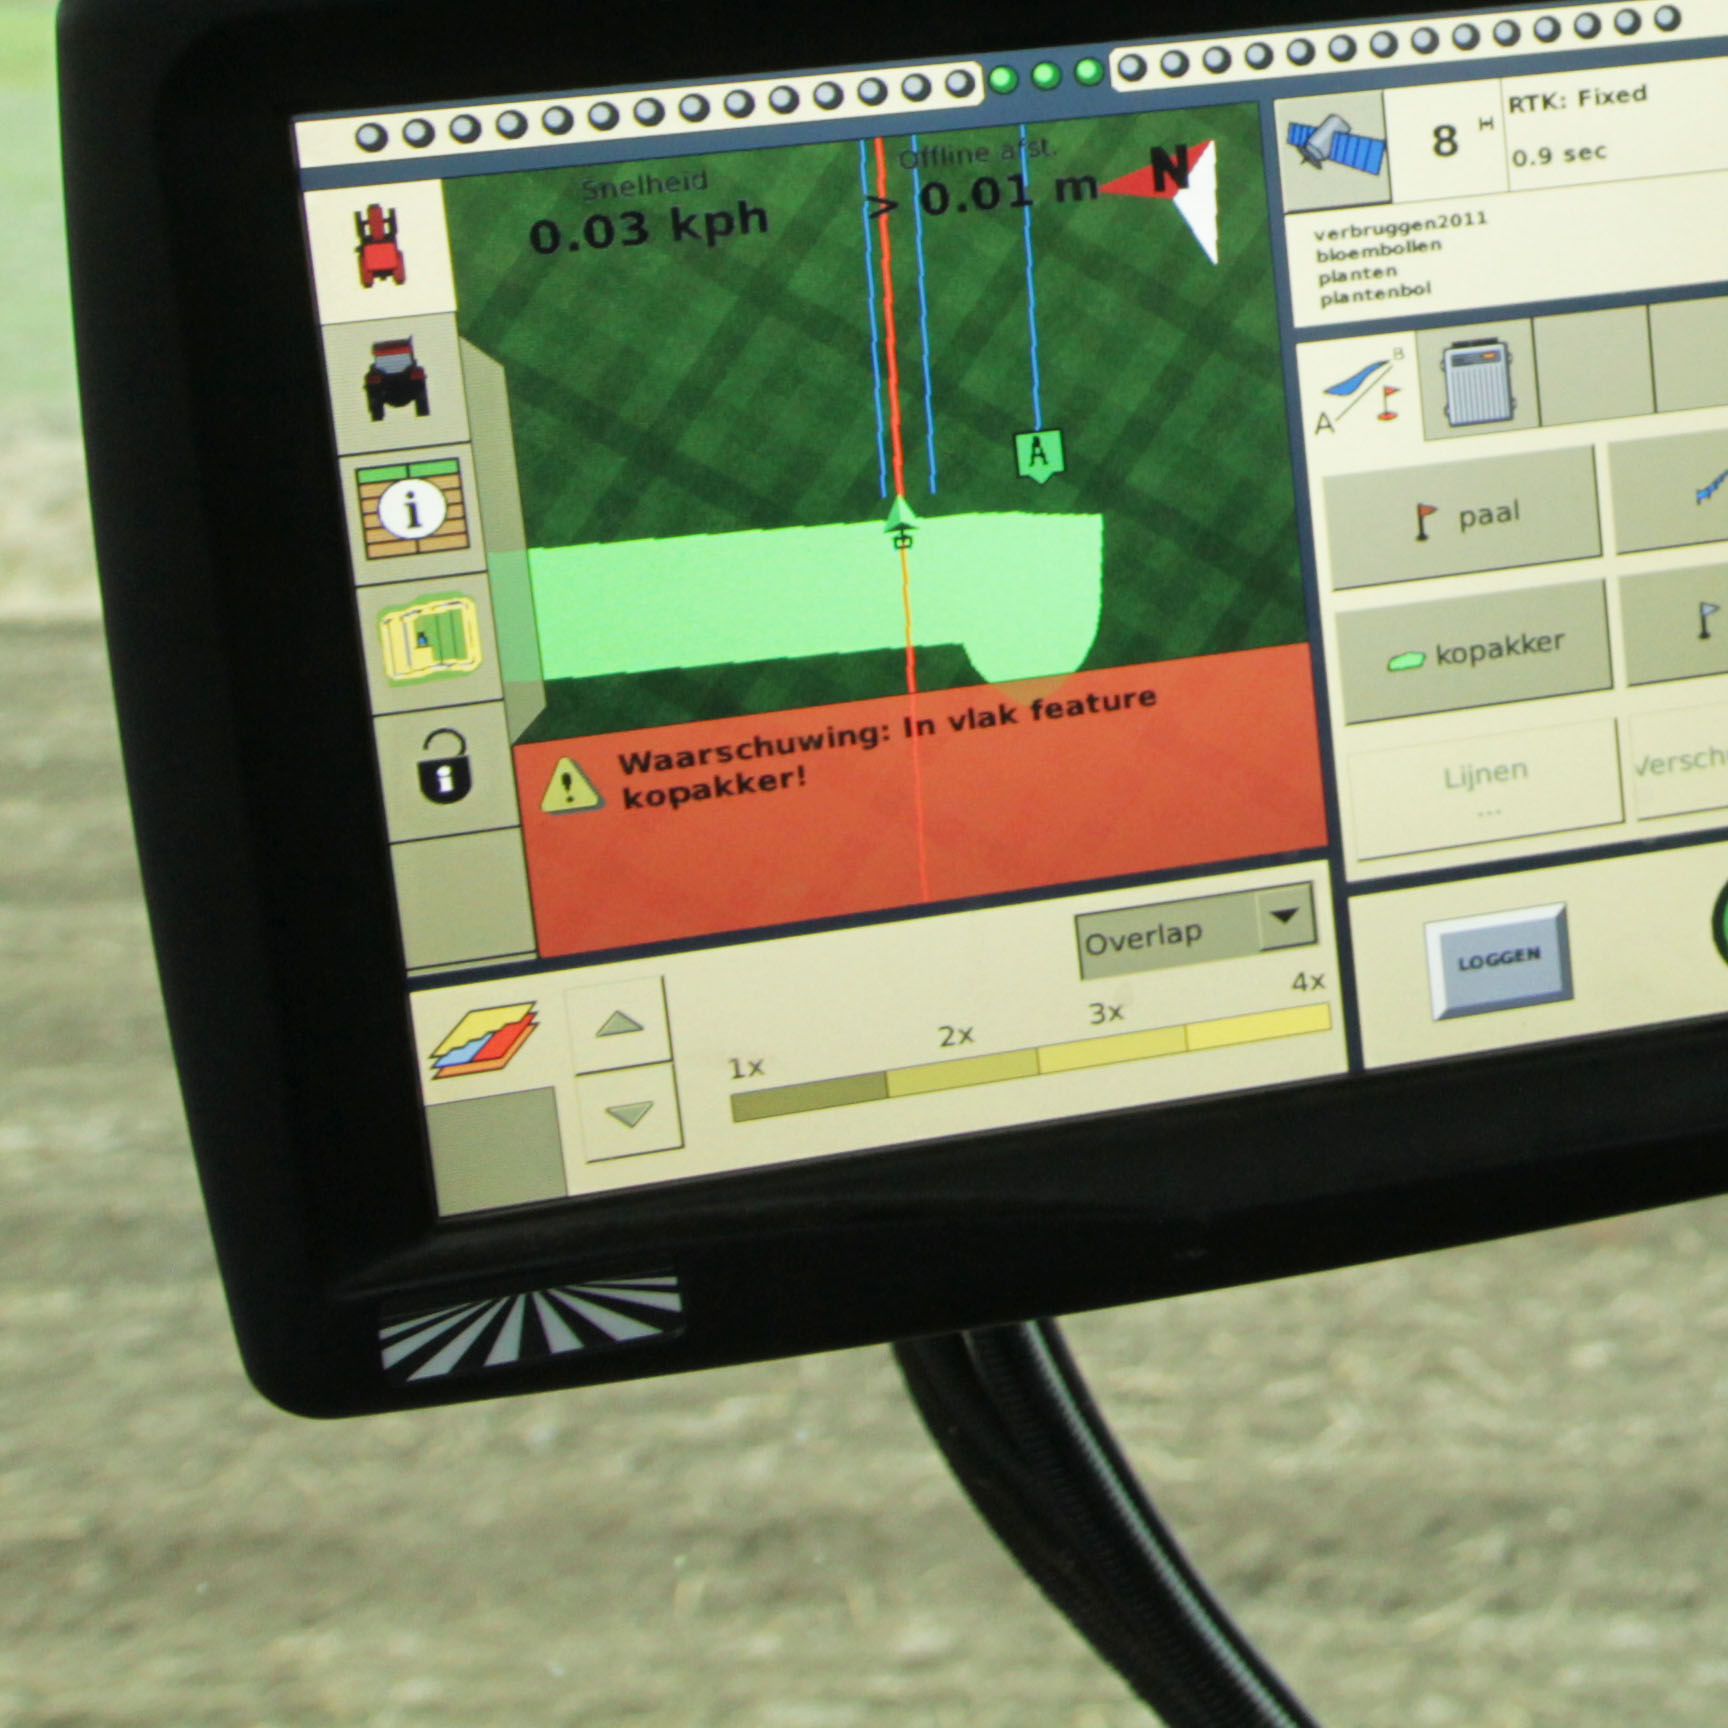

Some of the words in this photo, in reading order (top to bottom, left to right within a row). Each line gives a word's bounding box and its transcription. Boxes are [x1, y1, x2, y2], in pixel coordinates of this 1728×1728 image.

[1508, 95, 1566, 115] RTK:
[1578, 84, 1648, 107] Fixed
[1432, 124, 1459, 157] 8
[1511, 147, 1552, 167] 0.9
[1564, 144, 1607, 162] sec
[899, 142, 990, 171] Offline
[1149, 142, 1189, 194] N
[581, 171, 708, 202] Snelheid
[920, 174, 1034, 217] 0.01
[1056, 172, 1100, 203] m
[529, 211, 649, 255] 0.03
[671, 201, 769, 248] kph
[1314, 212, 1488, 242] verbruggen2011
[1316, 238, 1442, 263] bloembollen
[1319, 265, 1398, 288] planten
[1320, 282, 1431, 308] plantenbol
[1029, 436, 1048, 468] A
[1458, 499, 1520, 534] paal
[1435, 630, 1566, 668] kopakker
[617, 720, 891, 779] Waarschuwing:
[904, 710, 937, 742] In
[947, 701, 1018, 735] vlak
[1030, 684, 1159, 722] feature
[621, 764, 807, 813] kopakker!
[1444, 759, 1530, 795] Lijnen
[1084, 917, 1203, 962] Overlap
[1459, 945, 1542, 972] LOGGEN
[1291, 970, 1326, 994] 4x
[1089, 1002, 1125, 1025] 3x
[938, 1024, 975, 1048] 2x
[728, 1057, 765, 1081] 1x
